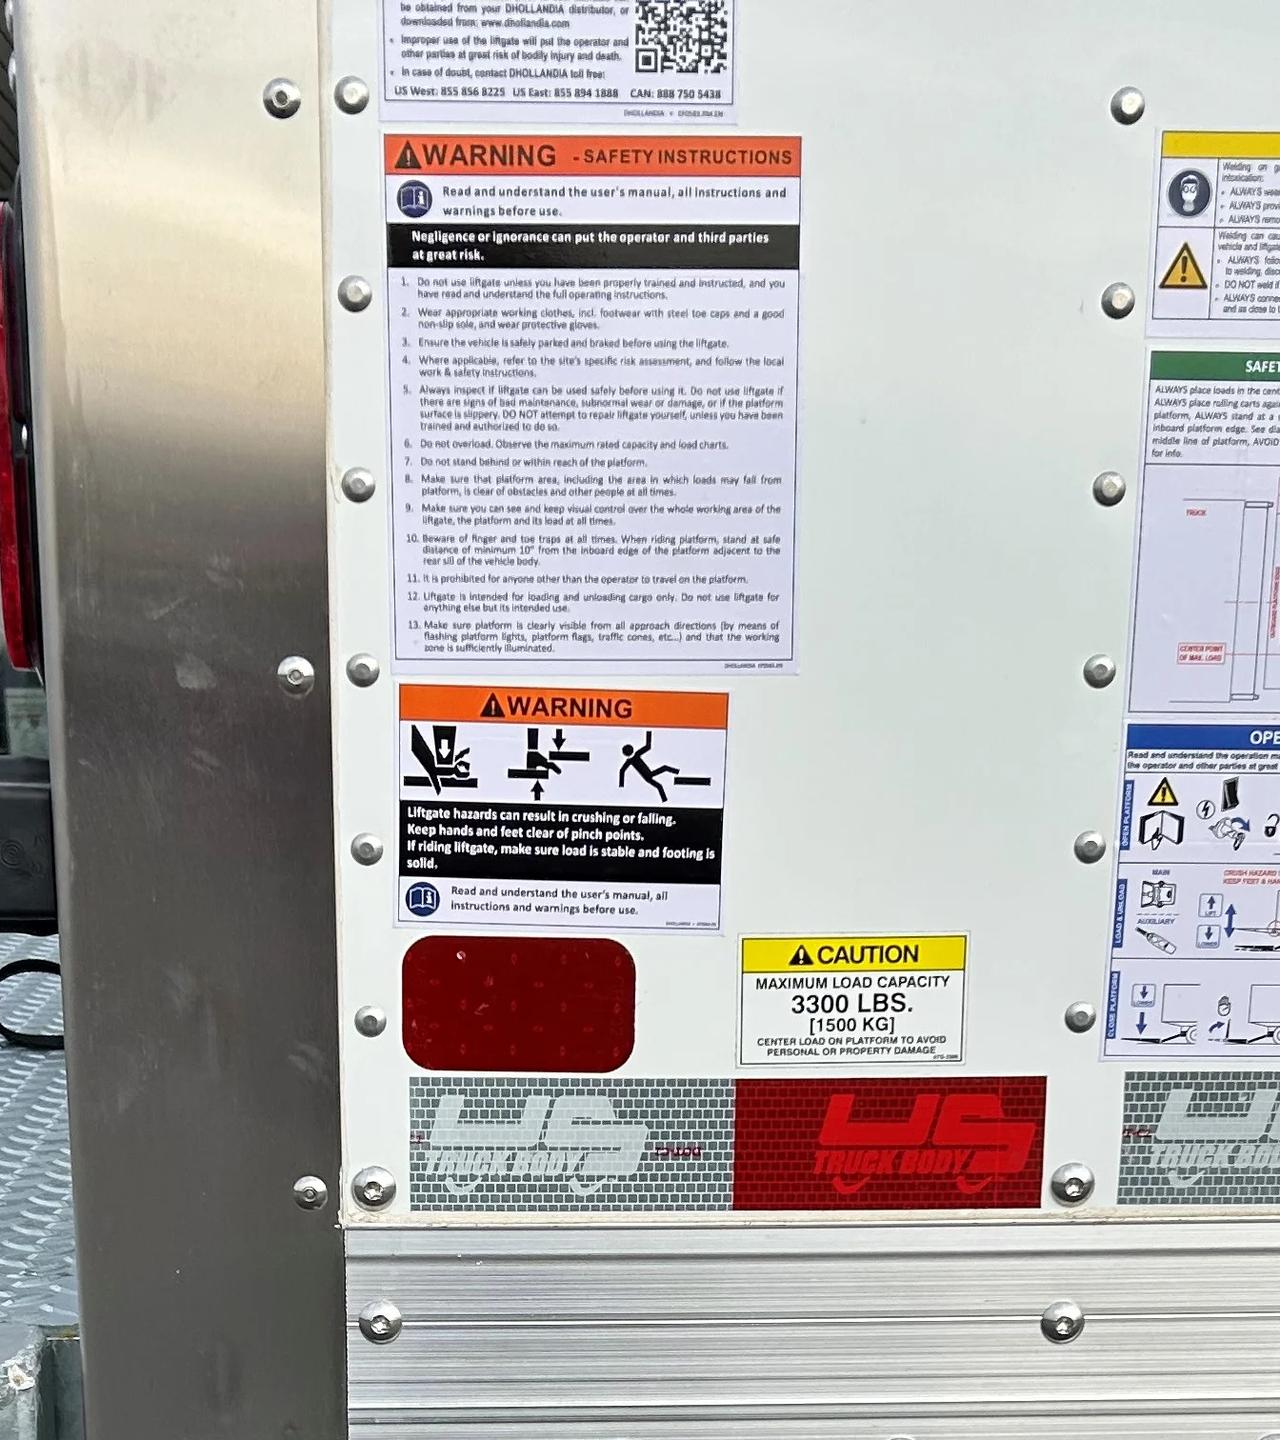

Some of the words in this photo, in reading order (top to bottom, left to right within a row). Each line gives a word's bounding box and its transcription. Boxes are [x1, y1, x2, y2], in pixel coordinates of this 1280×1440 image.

[394, 86, 407, 95] US
[410, 86, 438, 96] West:
[440, 86, 458, 96] 855
[461, 86, 479, 96] 856
[482, 87, 505, 96] 8225
[512, 87, 526, 96] US
[528, 88, 551, 97] East:
[554, 88, 571, 97] 855
[574, 88, 591, 98] 894
[595, 88, 618, 98] 1888
[630, 88, 654, 98] CAN:
[657, 88, 674, 98] 888
[678, 89, 694, 99] 750
[697, 89, 721, 99] 5438
[424, 144, 556, 168] WARNING
[584, 148, 653, 164] SAFETY
[658, 149, 792, 165] INSTRUCTIONS
[442, 186, 471, 196] Read
[474, 186, 495, 196] and
[498, 186, 565, 196] understand
[568, 186, 587, 197] the
[590, 186, 624, 197] user's
[628, 186, 674, 198] manual,
[678, 186, 691, 197] all
[695, 187, 761, 198] instructions
[765, 187, 788, 197] and
[443, 205, 495, 218] warnings
[498, 205, 535, 216] before
[539, 208, 562, 216] use.
[412, 230, 474, 244] Negligence
[478, 233, 488, 242] or
[493, 230, 549, 244] ignorance
[552, 233, 571, 242] can
[575, 232, 594, 244] put
[598, 230, 617, 242] the
[619, 232, 670, 245] operator
[673, 231, 696, 242] and
[698, 231, 726, 242] third
[728, 232, 769, 245] parties
[412, 250, 424, 260] at
[426, 250, 456, 262] great
[459, 248, 483, 260] risk.
[418, 337, 449, 347] Ensure
[450, 337, 466, 347] the
[468, 337, 499, 347] vehicle
[501, 338, 508, 347] is
[510, 337, 535, 348] safely
[538, 337, 568, 349] parked
[570, 338, 587, 348] and
[589, 338, 620, 348] braked
[622, 338, 651, 348] before
[654, 339, 677, 350] using
[679, 339, 694, 347] the
[696, 338, 729, 349] liftgate.
[508, 696, 632, 719] WARNING
[407, 806, 450, 821] Liftgate
[453, 807, 497, 820] hazards
[500, 811, 519, 820] can
[522, 809, 555, 821] result
[558, 810, 568, 822] in
[572, 810, 620, 825] crushing
[622, 814, 634, 823] or
[638, 812, 675, 827] falling.
[407, 823, 436, 837] Keep
[438, 824, 473, 836] hands
[476, 824, 497, 837] and
[500, 825, 523, 837] feet
[526, 826, 553, 838] clear
[556, 827, 568, 838] of
[571, 827, 602, 841] pinch
[605, 828, 643, 843] points.
[407, 839, 415, 851] If
[418, 840, 451, 854] riding
[454, 840, 497, 855] liftgate,
[500, 842, 531, 854] make
[534, 846, 558, 855] sure
[562, 844, 586, 856] load
[589, 845, 598, 856] is
[601, 845, 635, 857] stable
[638, 846, 659, 858] and
[662, 846, 703, 861] footing
[706, 848, 714, 859] is
[407, 857, 437, 868] solid.
[451, 886, 476, 895] Read
[479, 886, 498, 896] and
[501, 887, 557, 897] understand
[561, 888, 577, 898] the
[580, 889, 609, 899] user's
[612, 889, 652, 902] manual,
[655, 891, 667, 900] all
[451, 900, 509, 911] instructions
[513, 902, 531, 912] and
[535, 903, 579, 915] warnings
[582, 904, 615, 914] before
[817, 944, 918, 964] CAUTION
[756, 977, 827, 989] MAXIMUM
[832, 976, 872, 988] LOAD
[877, 975, 949, 987] CAPACITY
[792, 994, 848, 1013] 3300
[858, 992, 912, 1012] LBS.
[810, 1018, 856, 1035] [1500
[862, 1016, 894, 1034] KG]
[757, 1037, 796, 1046] CENTER
[799, 1037, 825, 1045] LOAD
[828, 1037, 842, 1045] ON
[845, 1036, 897, 1045] PLATFORM
[901, 1036, 914, 1044] TO
[916, 1035, 946, 1044] AVOID
[767, 1048, 818, 1056] PERSONAL
[822, 1047, 836, 1055] OR
[839, 1046, 891, 1055] PROPERTY
[894, 1046, 935, 1054] DAMAGE
[430, 1095, 649, 1175] US
[820, 1094, 1036, 1173] US
[425, 1151, 511, 1174] TRUCK
[512, 1151, 584, 1174] BODY
[813, 1151, 897, 1174] TRUCK
[899, 1151, 970, 1174] BODY
[1149, 1145, 1233, 1168] TRUCK
